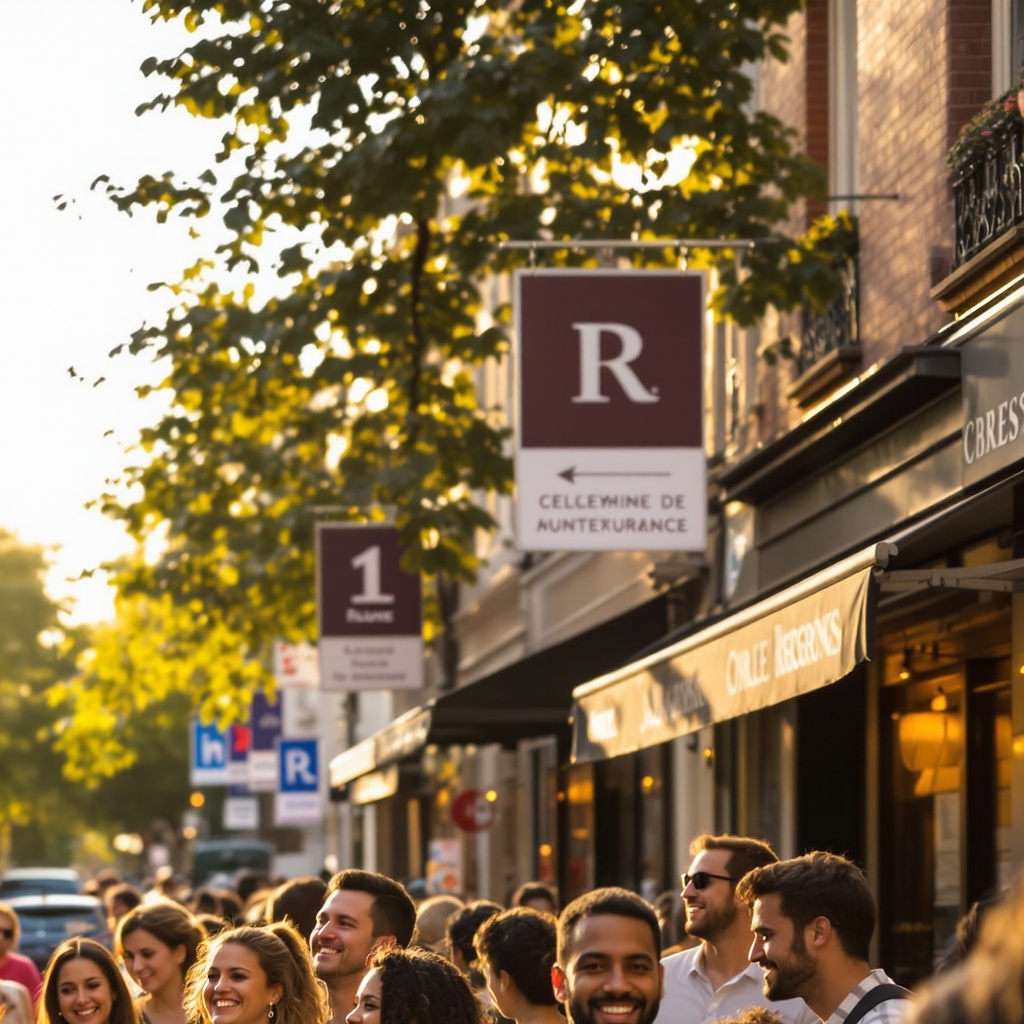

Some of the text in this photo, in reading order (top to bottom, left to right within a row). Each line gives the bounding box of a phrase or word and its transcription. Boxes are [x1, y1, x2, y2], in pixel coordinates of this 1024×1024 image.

[661, 494, 686, 509] DE
[350, 545, 395, 605] 1
[285, 748, 316, 784] R
